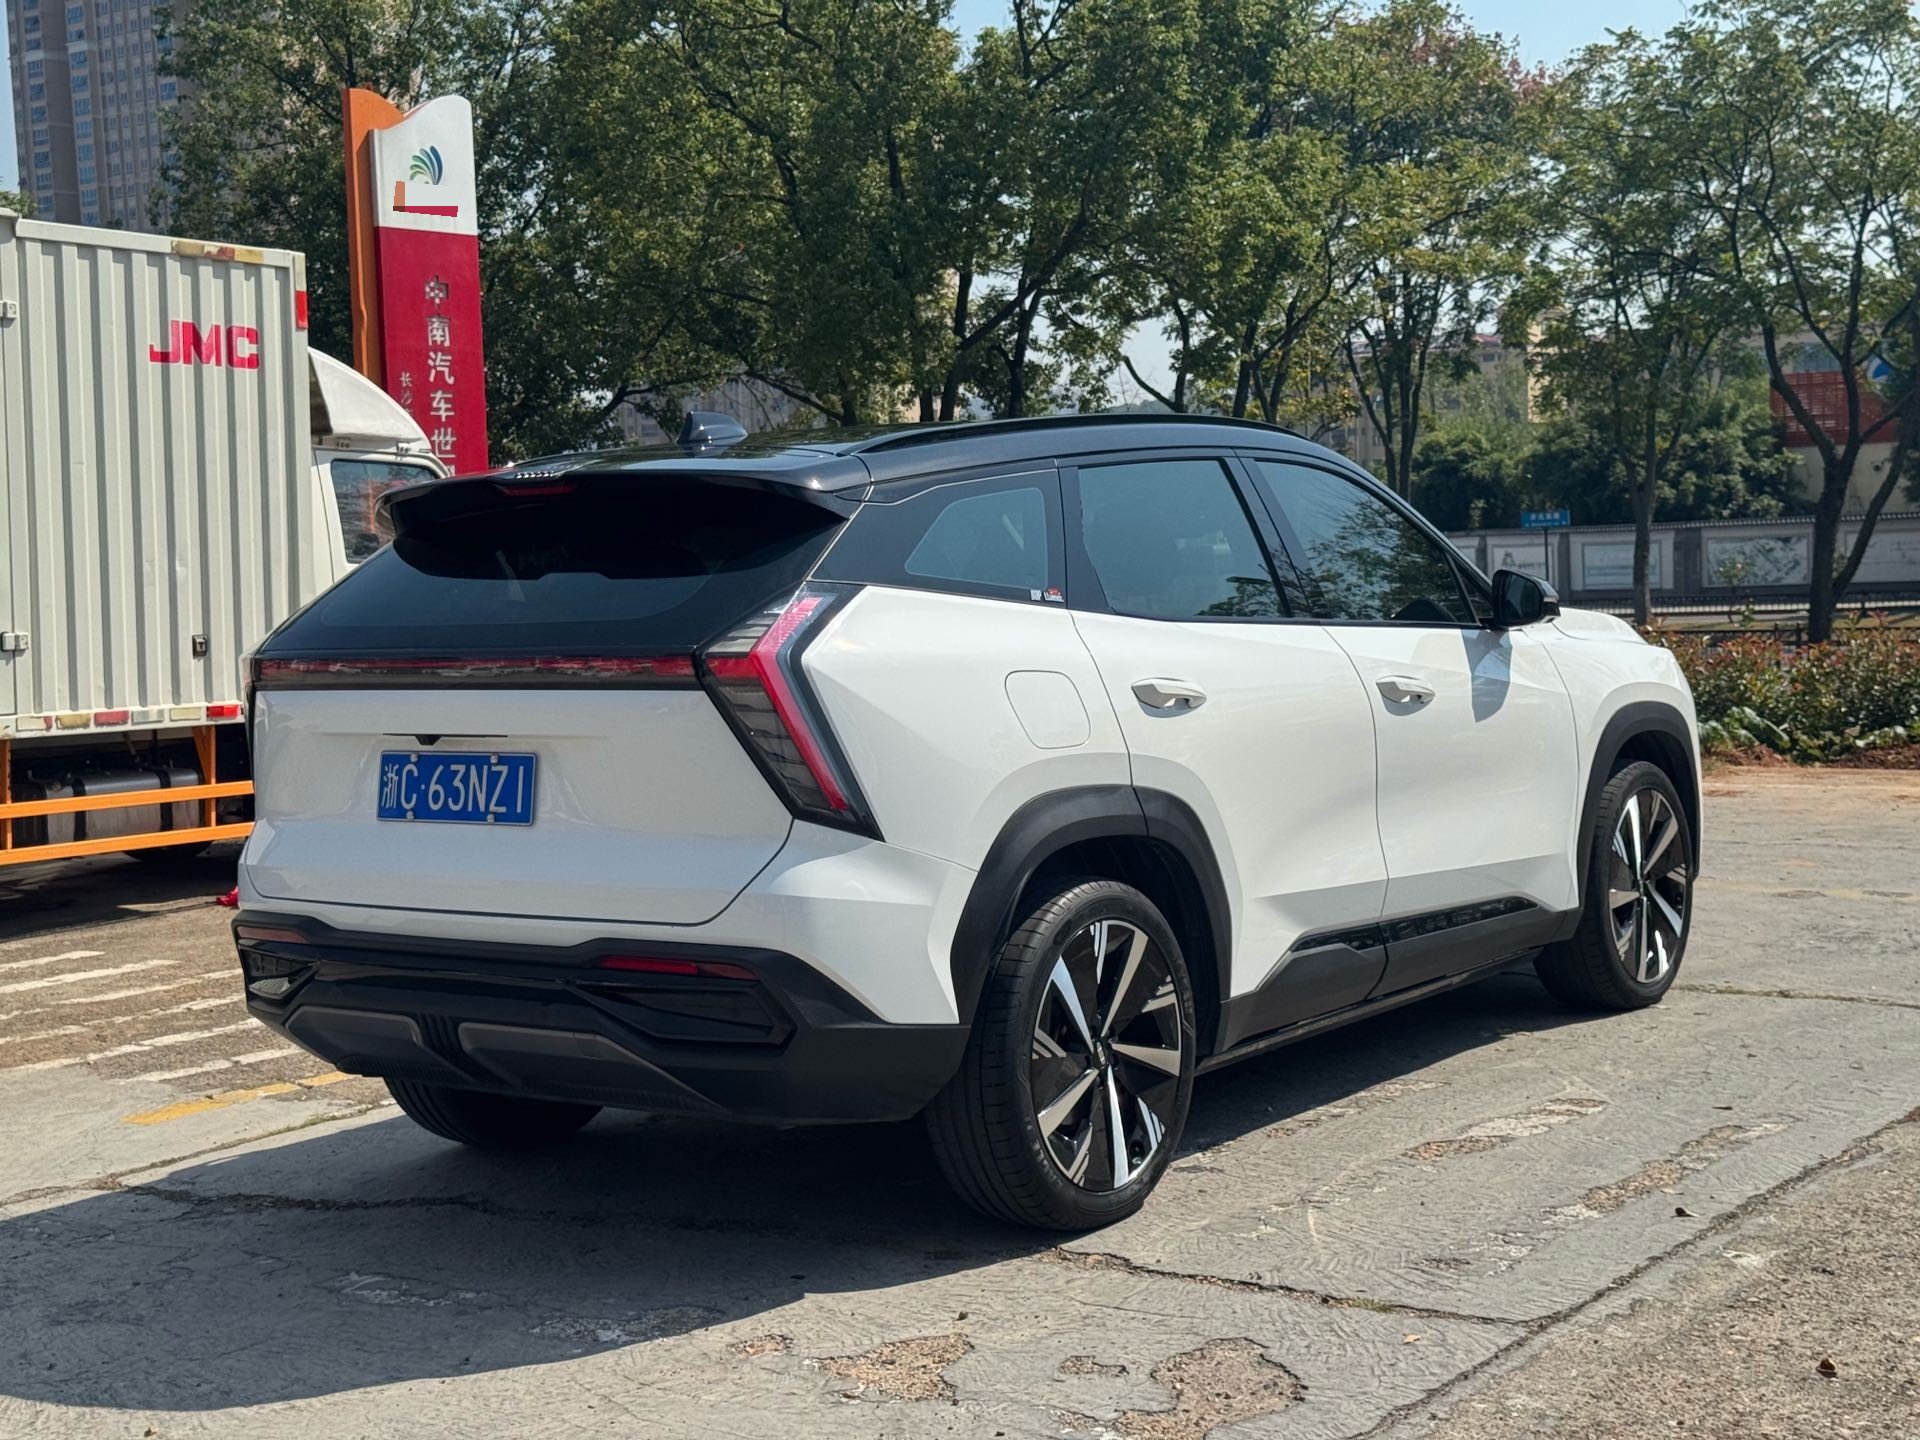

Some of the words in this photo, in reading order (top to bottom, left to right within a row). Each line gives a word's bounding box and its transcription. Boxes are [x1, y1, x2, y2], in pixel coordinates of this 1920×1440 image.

[149, 320, 260, 370] JMC
[399, 371, 414, 417] 长沙
[424, 274, 457, 478] 中南汽车世
